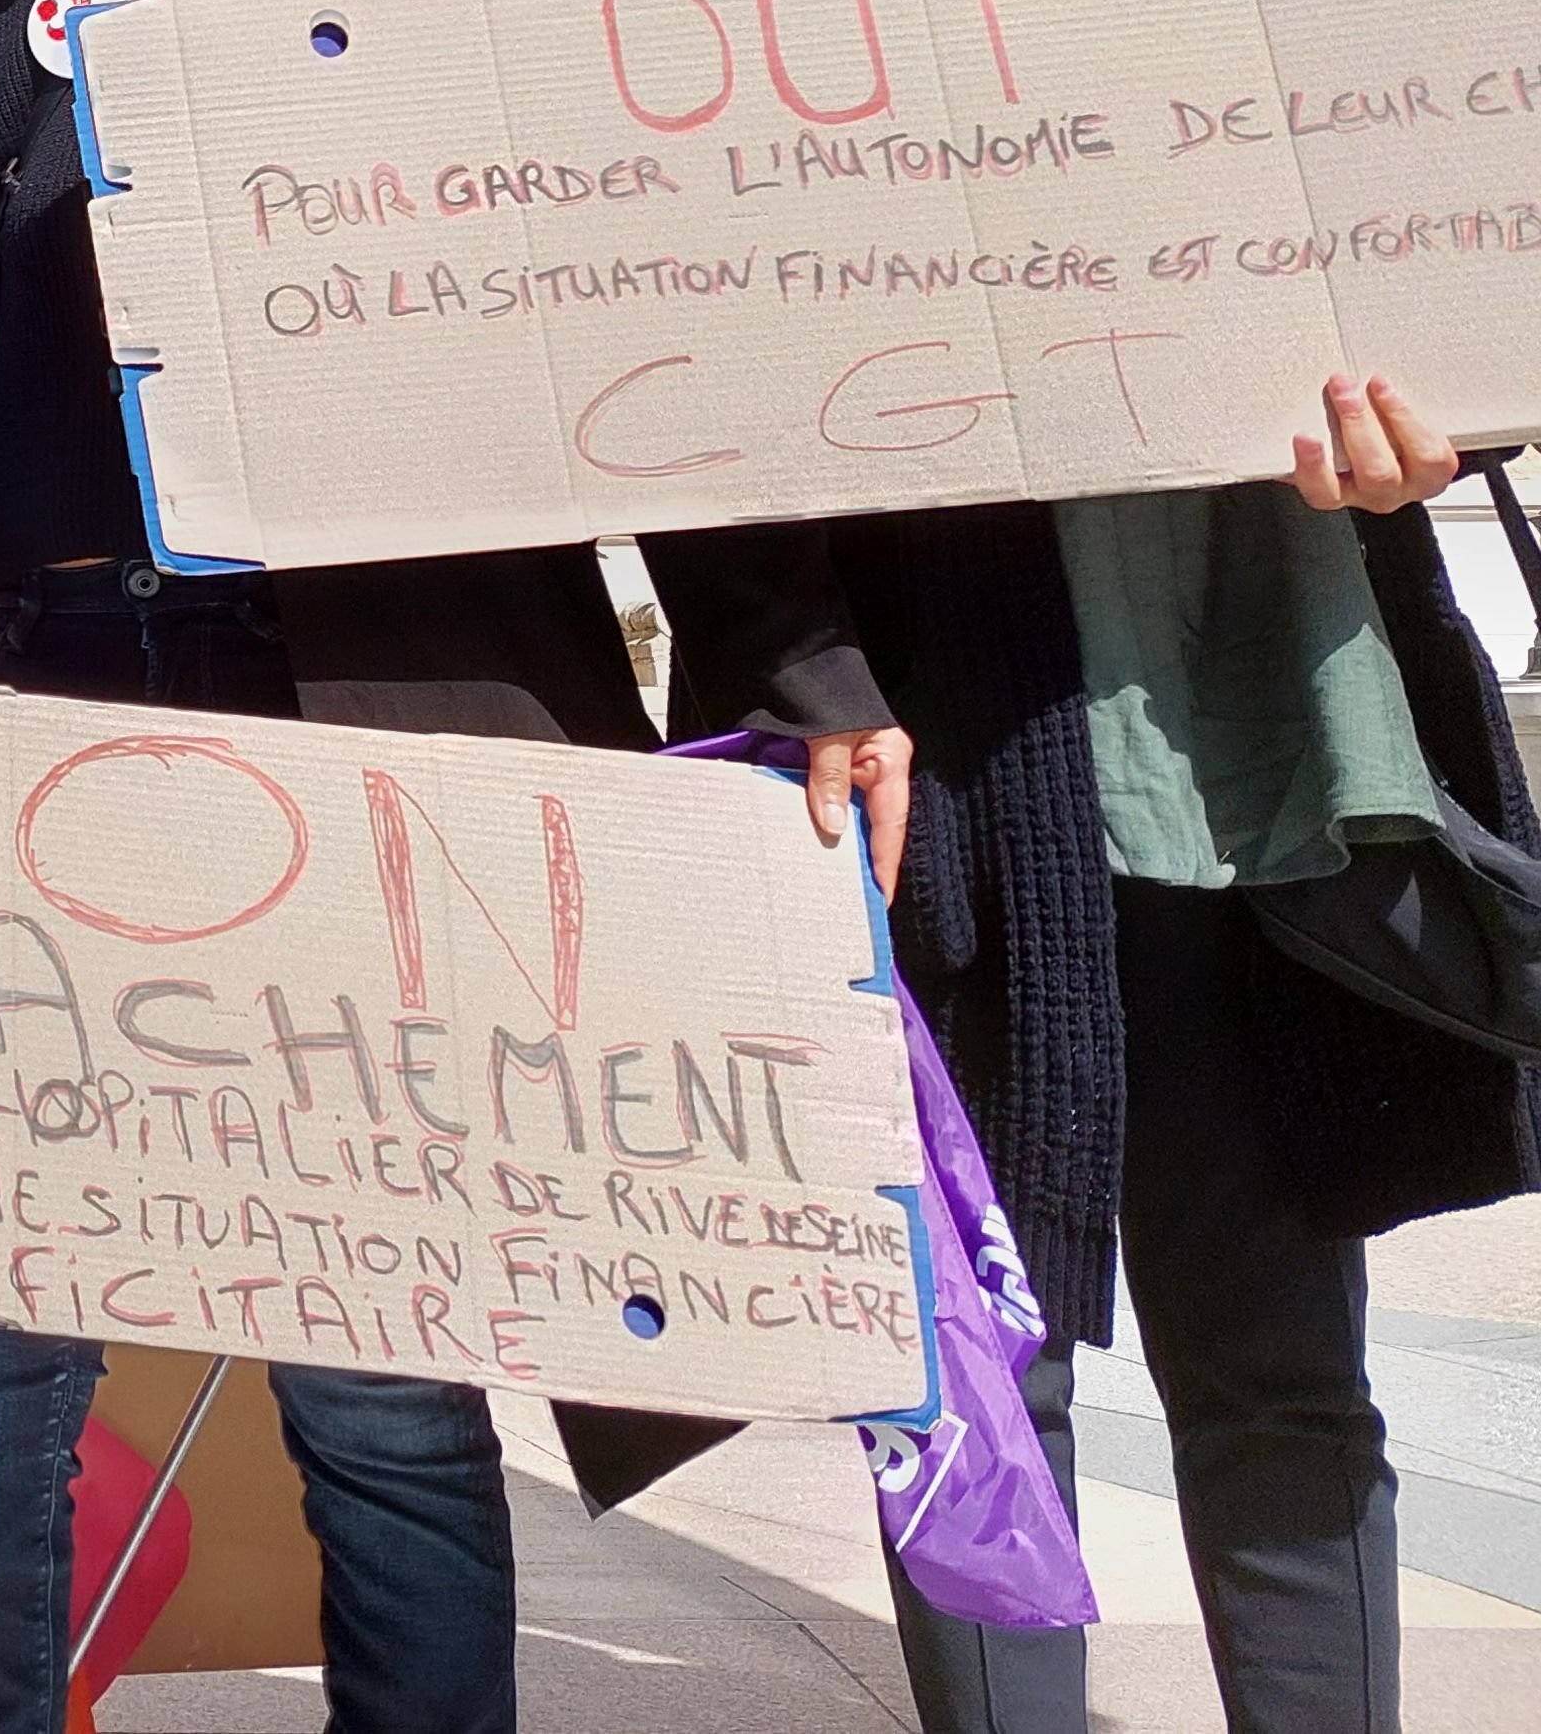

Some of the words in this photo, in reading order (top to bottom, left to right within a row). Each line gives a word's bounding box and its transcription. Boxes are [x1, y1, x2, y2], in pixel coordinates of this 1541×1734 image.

[242, 163, 417, 246] POUR
[435, 154, 682, 217] GARDER
[1167, 97, 1274, 159] DE
[1288, 76, 1454, 135] LEUR
[388, 259, 469, 318] LA
[1148, 233, 1221, 281] EST
[576, 329, 1185, 479] CGT
[488, 1160, 590, 1222] DE
